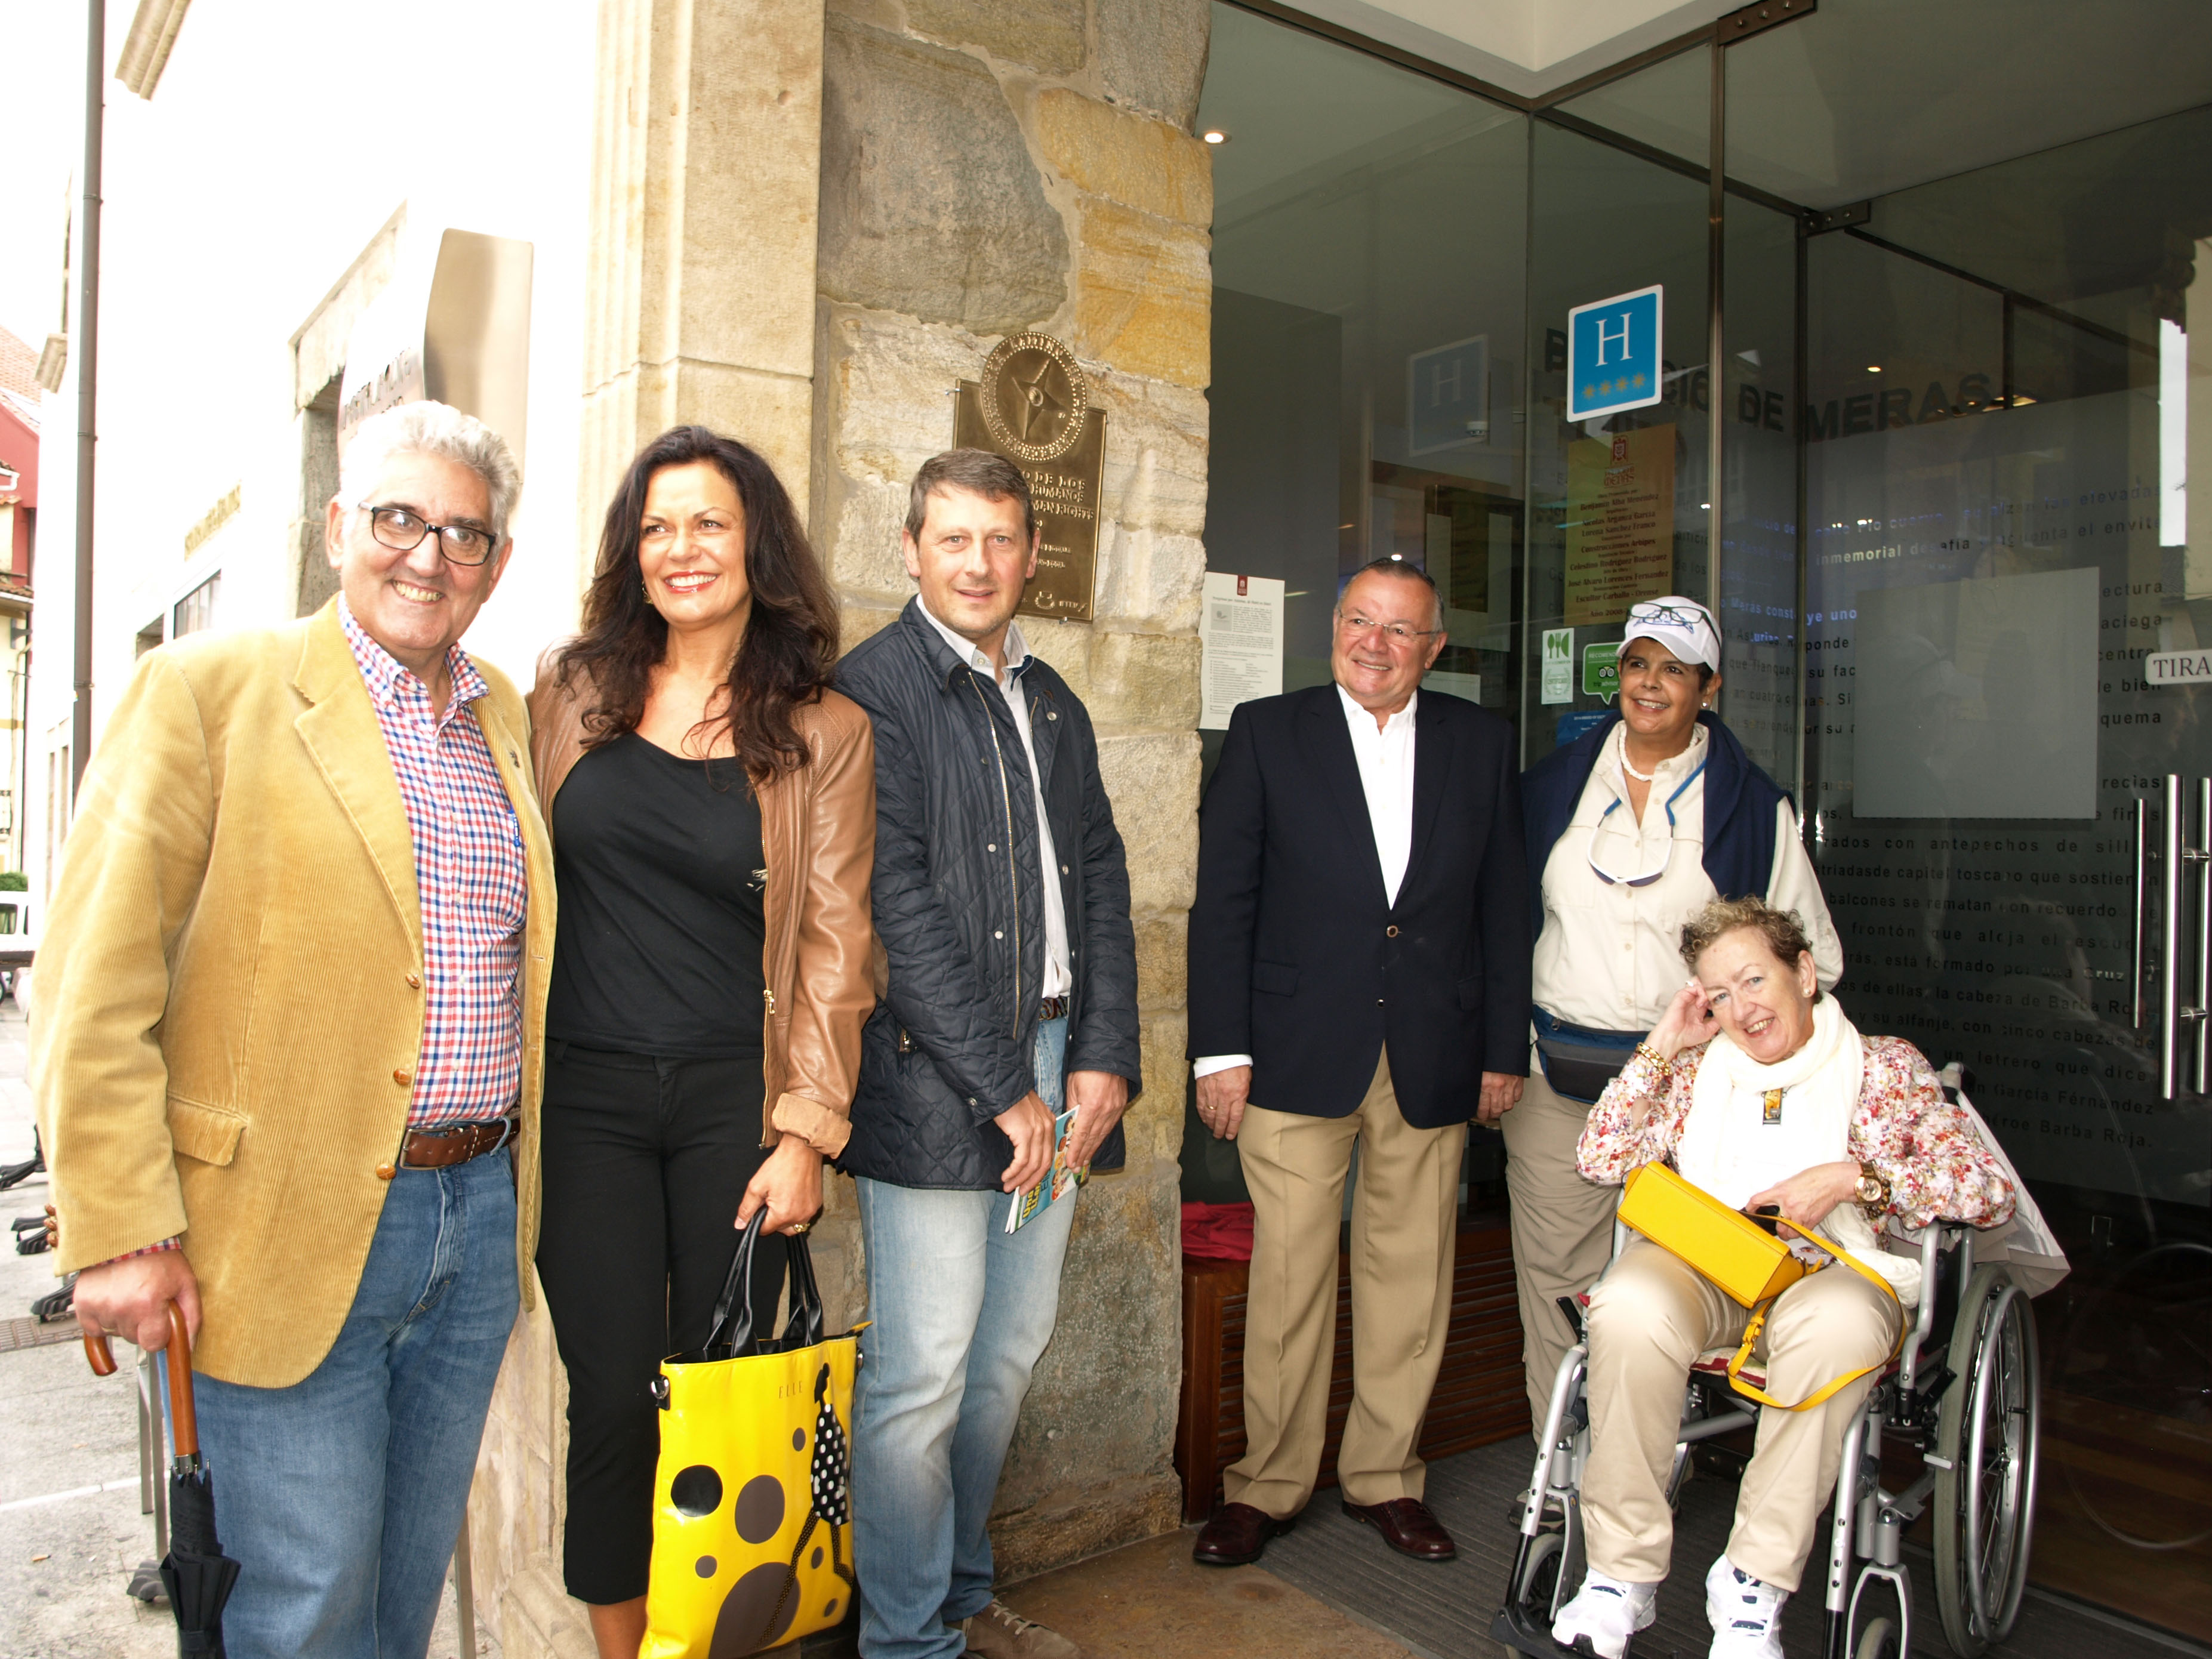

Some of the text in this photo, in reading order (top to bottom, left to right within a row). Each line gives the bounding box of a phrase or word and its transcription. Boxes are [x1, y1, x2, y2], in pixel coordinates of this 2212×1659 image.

[1595, 312, 1633, 367] H
[1737, 383, 1784, 432] DE
[1036, 471, 1086, 491] DE LOS
[1031, 483, 1085, 502] HUMANOS
[1033, 500, 1095, 520] MAN RIGHTS
[1816, 543, 1902, 567] inmemorial
[2102, 580, 2164, 597] ectura
[1830, 608, 1857, 621] uno
[2100, 612, 2163, 630] aciega
[1833, 664, 1857, 678] fac
[1838, 693, 1851, 705] Si
[2102, 775, 2160, 789] recias
[1884, 838, 1914, 850] con
[1930, 838, 2040, 855] antepechos
[2056, 839, 2078, 853] de
[1897, 866, 1950, 881] capitel
[1957, 869, 2023, 883] toscano
[2031, 874, 2061, 886] que
[1829, 893, 1896, 908] balcones
[1902, 898, 1920, 909] se
[1927, 898, 1992, 913] rematan
[1851, 921, 1916, 938] frontón
[1932, 929, 1963, 941] que
[2041, 933, 2057, 946] el
[1926, 955, 1995, 974] formado
[1863, 982, 1880, 993] de
[1936, 986, 1949, 1001] la
[1956, 988, 2013, 1005] cabeza
[2021, 993, 2041, 1007] de
[2048, 995, 2100, 1013] Barba
[1872, 1013, 1891, 1024] su
[1962, 1020, 1992, 1034] con
[2001, 1024, 2045, 1040] cinco
[2053, 1029, 2126, 1047] cabezas
[2134, 1035, 2156, 1050] de
[1977, 1050, 2041, 1071] letrero
[2054, 1063, 2090, 1079] que
[2040, 1118, 2093, 1140] Barba
[778, 1379, 803, 1399] ELLE
